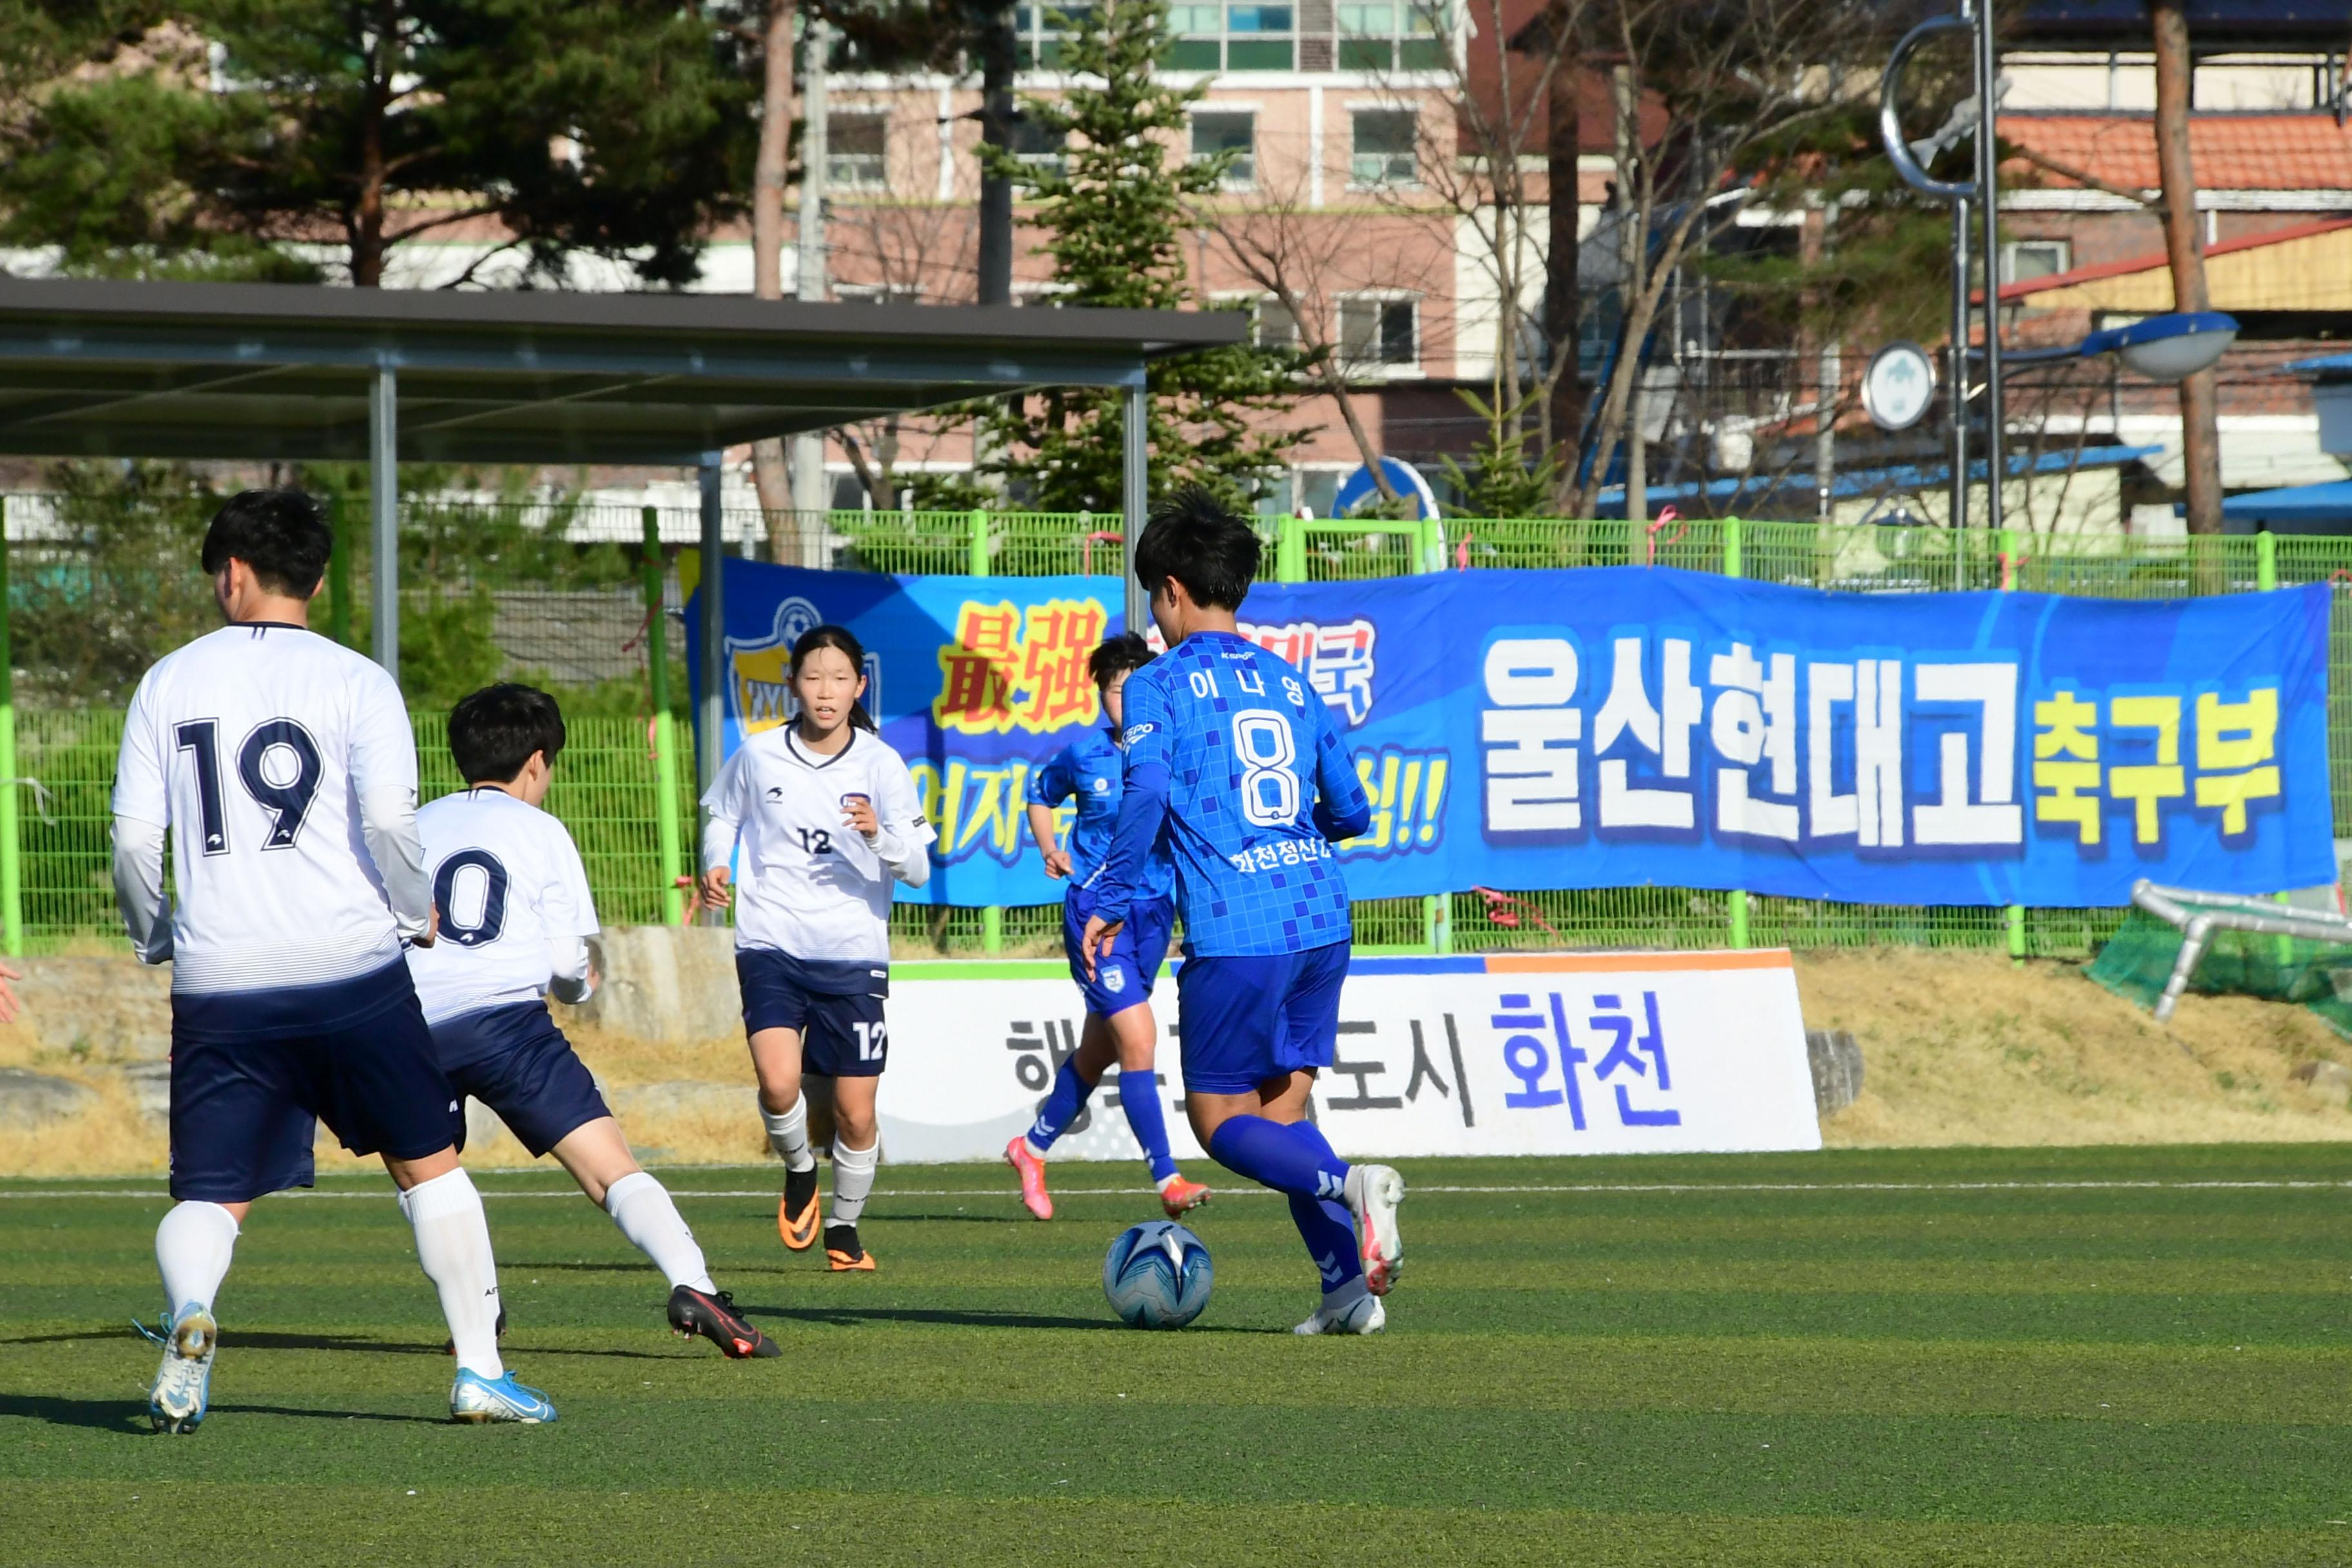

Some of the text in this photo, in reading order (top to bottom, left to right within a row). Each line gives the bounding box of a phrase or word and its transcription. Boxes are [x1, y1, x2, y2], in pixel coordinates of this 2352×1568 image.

[173, 716, 325, 856] 19
[1232, 709, 1300, 826] 8
[1482, 637, 2280, 847] 울산현대고 축구부
[797, 827, 832, 854] 12
[853, 1021, 887, 1061] 12
[1490, 991, 1681, 1132] 화천
